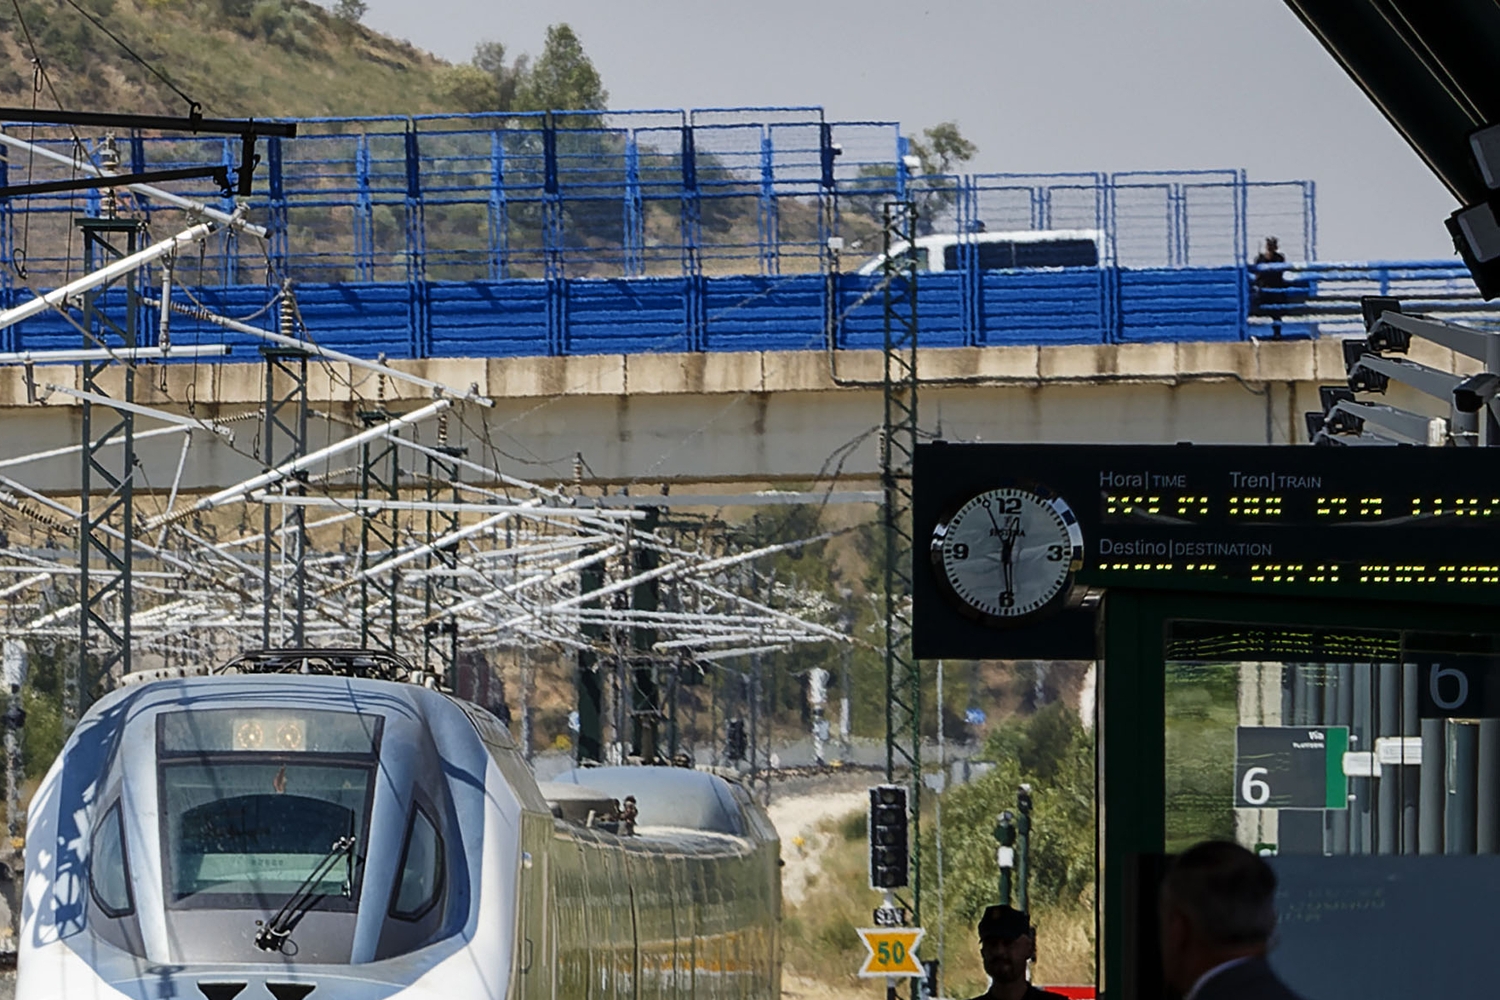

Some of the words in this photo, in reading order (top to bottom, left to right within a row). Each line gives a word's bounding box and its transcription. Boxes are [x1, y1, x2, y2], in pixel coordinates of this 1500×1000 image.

[1100, 471, 1143, 488] Hora
[1152, 475, 1186, 488] TIME
[1229, 471, 1270, 488] Tren
[1277, 476, 1322, 489] TRAIN
[996, 498, 1022, 514] 12
[952, 543, 969, 560] 9
[1046, 544, 1064, 562] 3
[1099, 538, 1167, 556] Destino
[1174, 543, 1273, 556] DESTINATION
[999, 591, 1015, 608] 6
[1241, 767, 1271, 805] 6
[877, 940, 906, 966] 50
